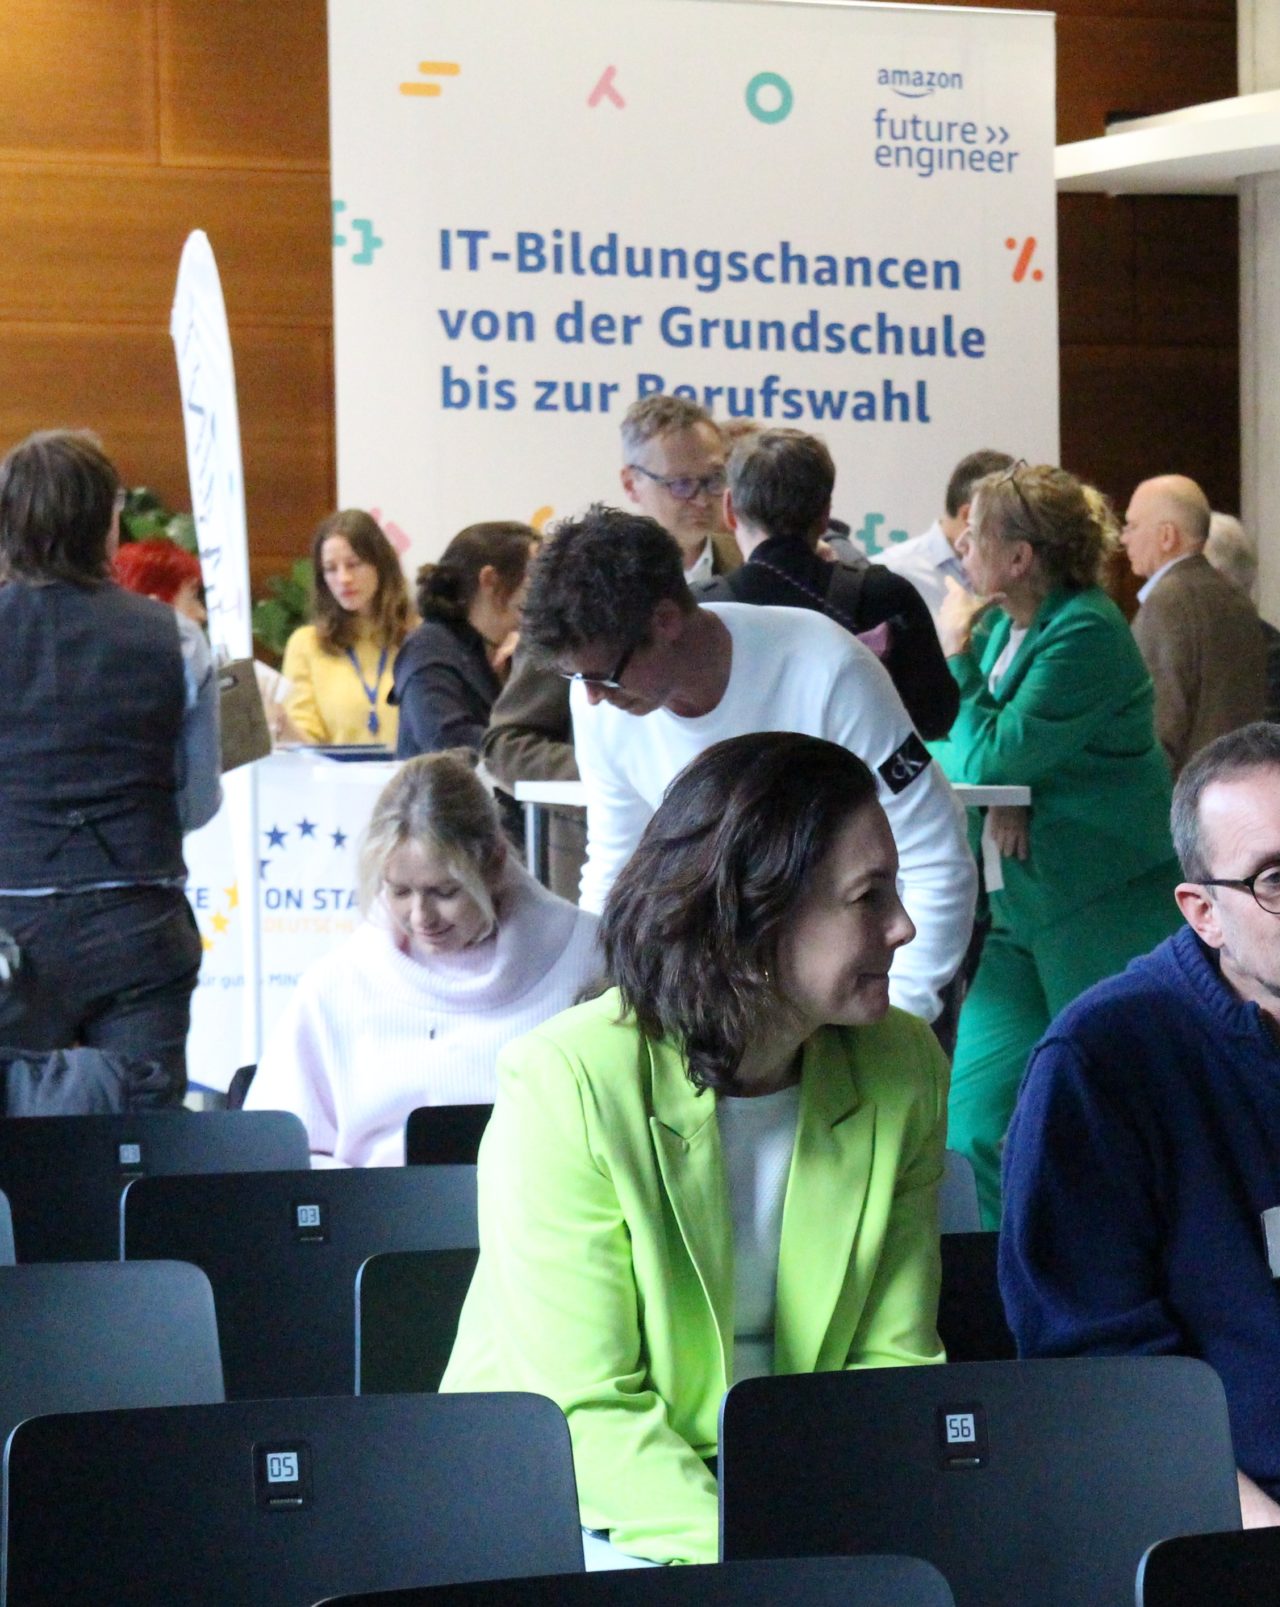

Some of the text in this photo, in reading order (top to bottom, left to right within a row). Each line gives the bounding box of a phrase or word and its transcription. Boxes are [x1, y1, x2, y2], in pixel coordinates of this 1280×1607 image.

[876, 68, 964, 90] amazon
[874, 108, 978, 145] future
[874, 144, 1020, 178] engineer
[440, 228, 961, 292] IT-Bildungschancen
[438, 300, 986, 359] von der Grundschule
[441, 365, 517, 412] bis
[534, 379, 620, 414] zur
[264, 887, 304, 911] ON
[313, 887, 360, 911] STA
[299, 1208, 317, 1224] 03
[948, 1417, 972, 1439] 56
[269, 1456, 294, 1478] 05
